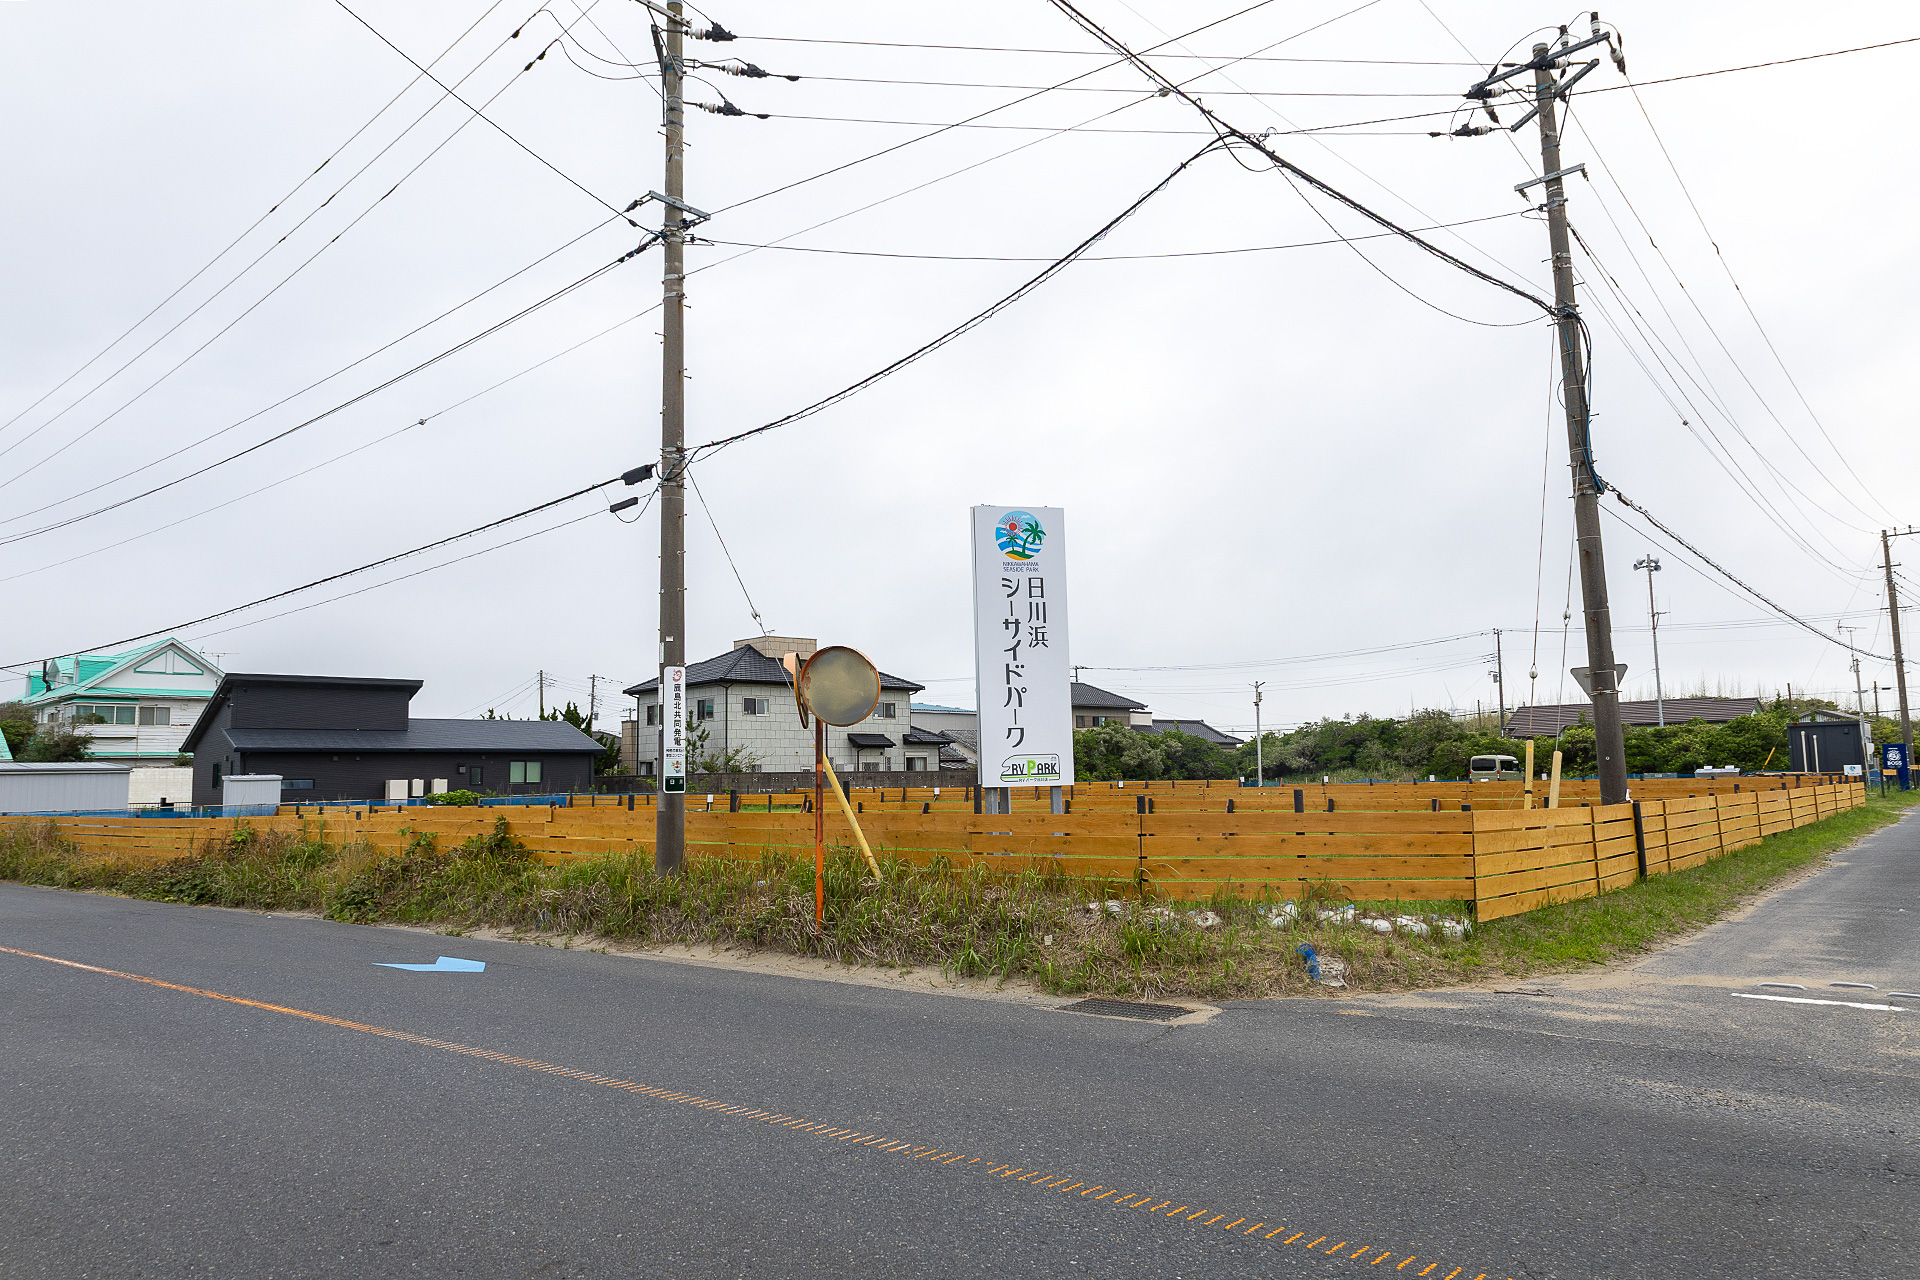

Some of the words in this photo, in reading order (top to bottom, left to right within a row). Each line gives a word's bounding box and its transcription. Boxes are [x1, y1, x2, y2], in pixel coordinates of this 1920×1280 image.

[1027, 577, 1049, 649] 日川浜
[1001, 577, 1027, 748] シーサイドパーク
[1011, 763, 1025, 775] RV
[1026, 759, 1058, 777] PARK
